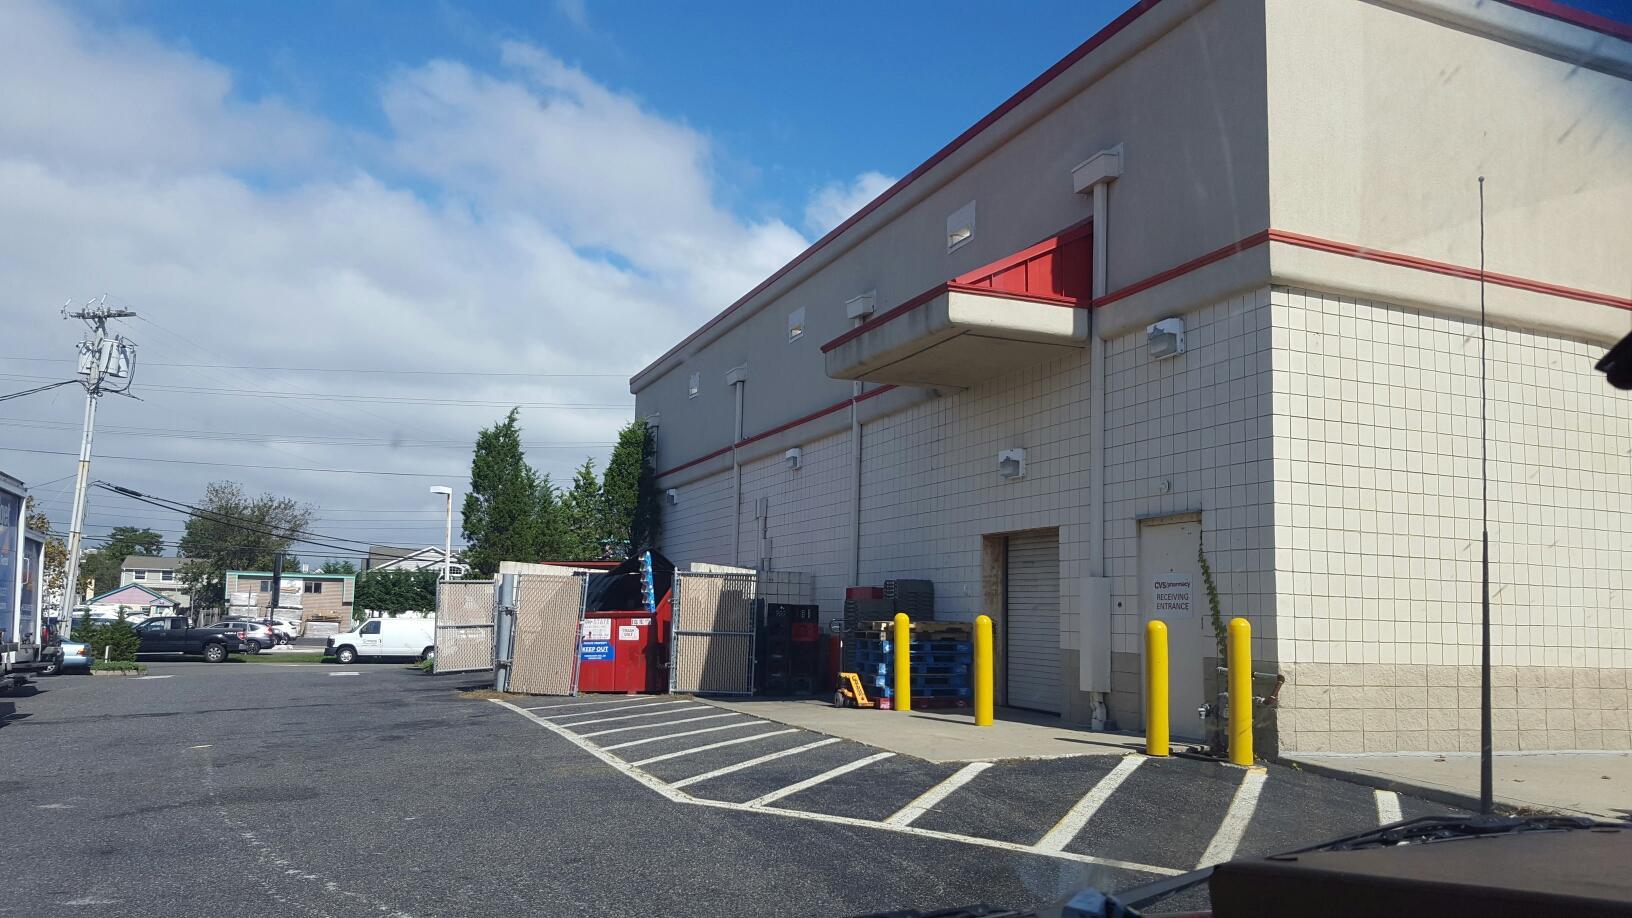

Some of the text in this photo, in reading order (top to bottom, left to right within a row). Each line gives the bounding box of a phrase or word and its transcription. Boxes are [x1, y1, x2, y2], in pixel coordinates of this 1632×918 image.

[1154, 581, 1167, 589] CVS
[1156, 593, 1189, 601] RECEIVING
[1156, 602, 1190, 610] ENTRANCE
